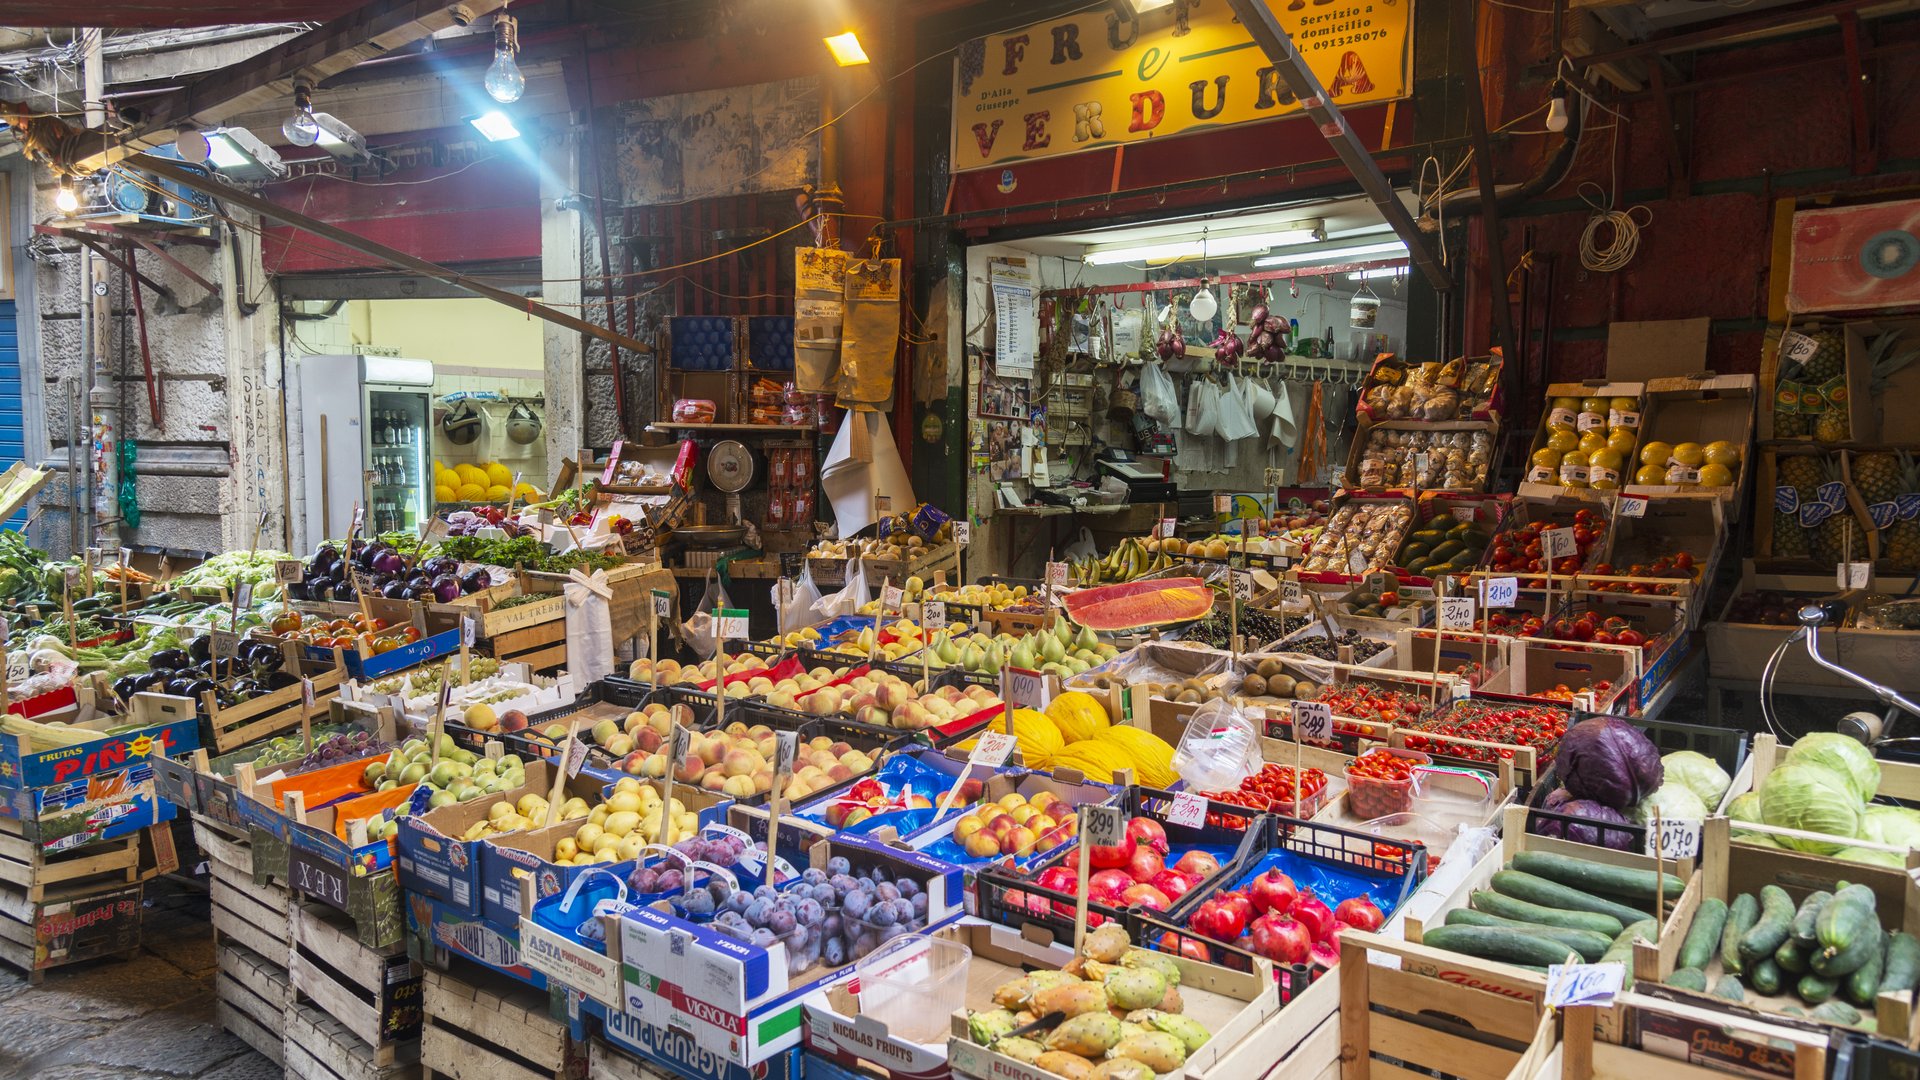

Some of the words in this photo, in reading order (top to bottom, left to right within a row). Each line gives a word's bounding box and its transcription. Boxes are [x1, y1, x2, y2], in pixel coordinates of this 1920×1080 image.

[1297, 5, 1359, 27] Servizio
[1364, 4, 1372, 14] a
[1002, 0, 1338, 77] FRUT
[1298, 17, 1369, 41] domicilio
[1311, 28, 1385, 51] 091328076
[1136, 45, 1171, 83] e
[971, 51, 1373, 158] VERDURA
[976, 97, 1021, 112] Giuseppe
[981, 87, 1012, 100] D'Alia
[1622, 499, 1641, 513] 160
[281, 564, 296, 578] 150
[505, 612, 526, 624] VAL
[655, 599, 667, 615] 160
[927, 609, 941, 620] 200
[5, 665, 25, 680] 150
[39, 747, 83, 763] FRUTAS
[1087, 809, 1114, 835] 299
[297, 860, 343, 904] REX
[117, 900, 135, 916] Le
[530, 935, 562, 961] ASTA
[839, 966, 854, 977] PLUM
[685, 996, 735, 1032] VIGNOLA
[832, 1021, 874, 1048] NICOLAS
[876, 1037, 913, 1063] FRUITS
[1691, 1028, 1744, 1060] Gusto
